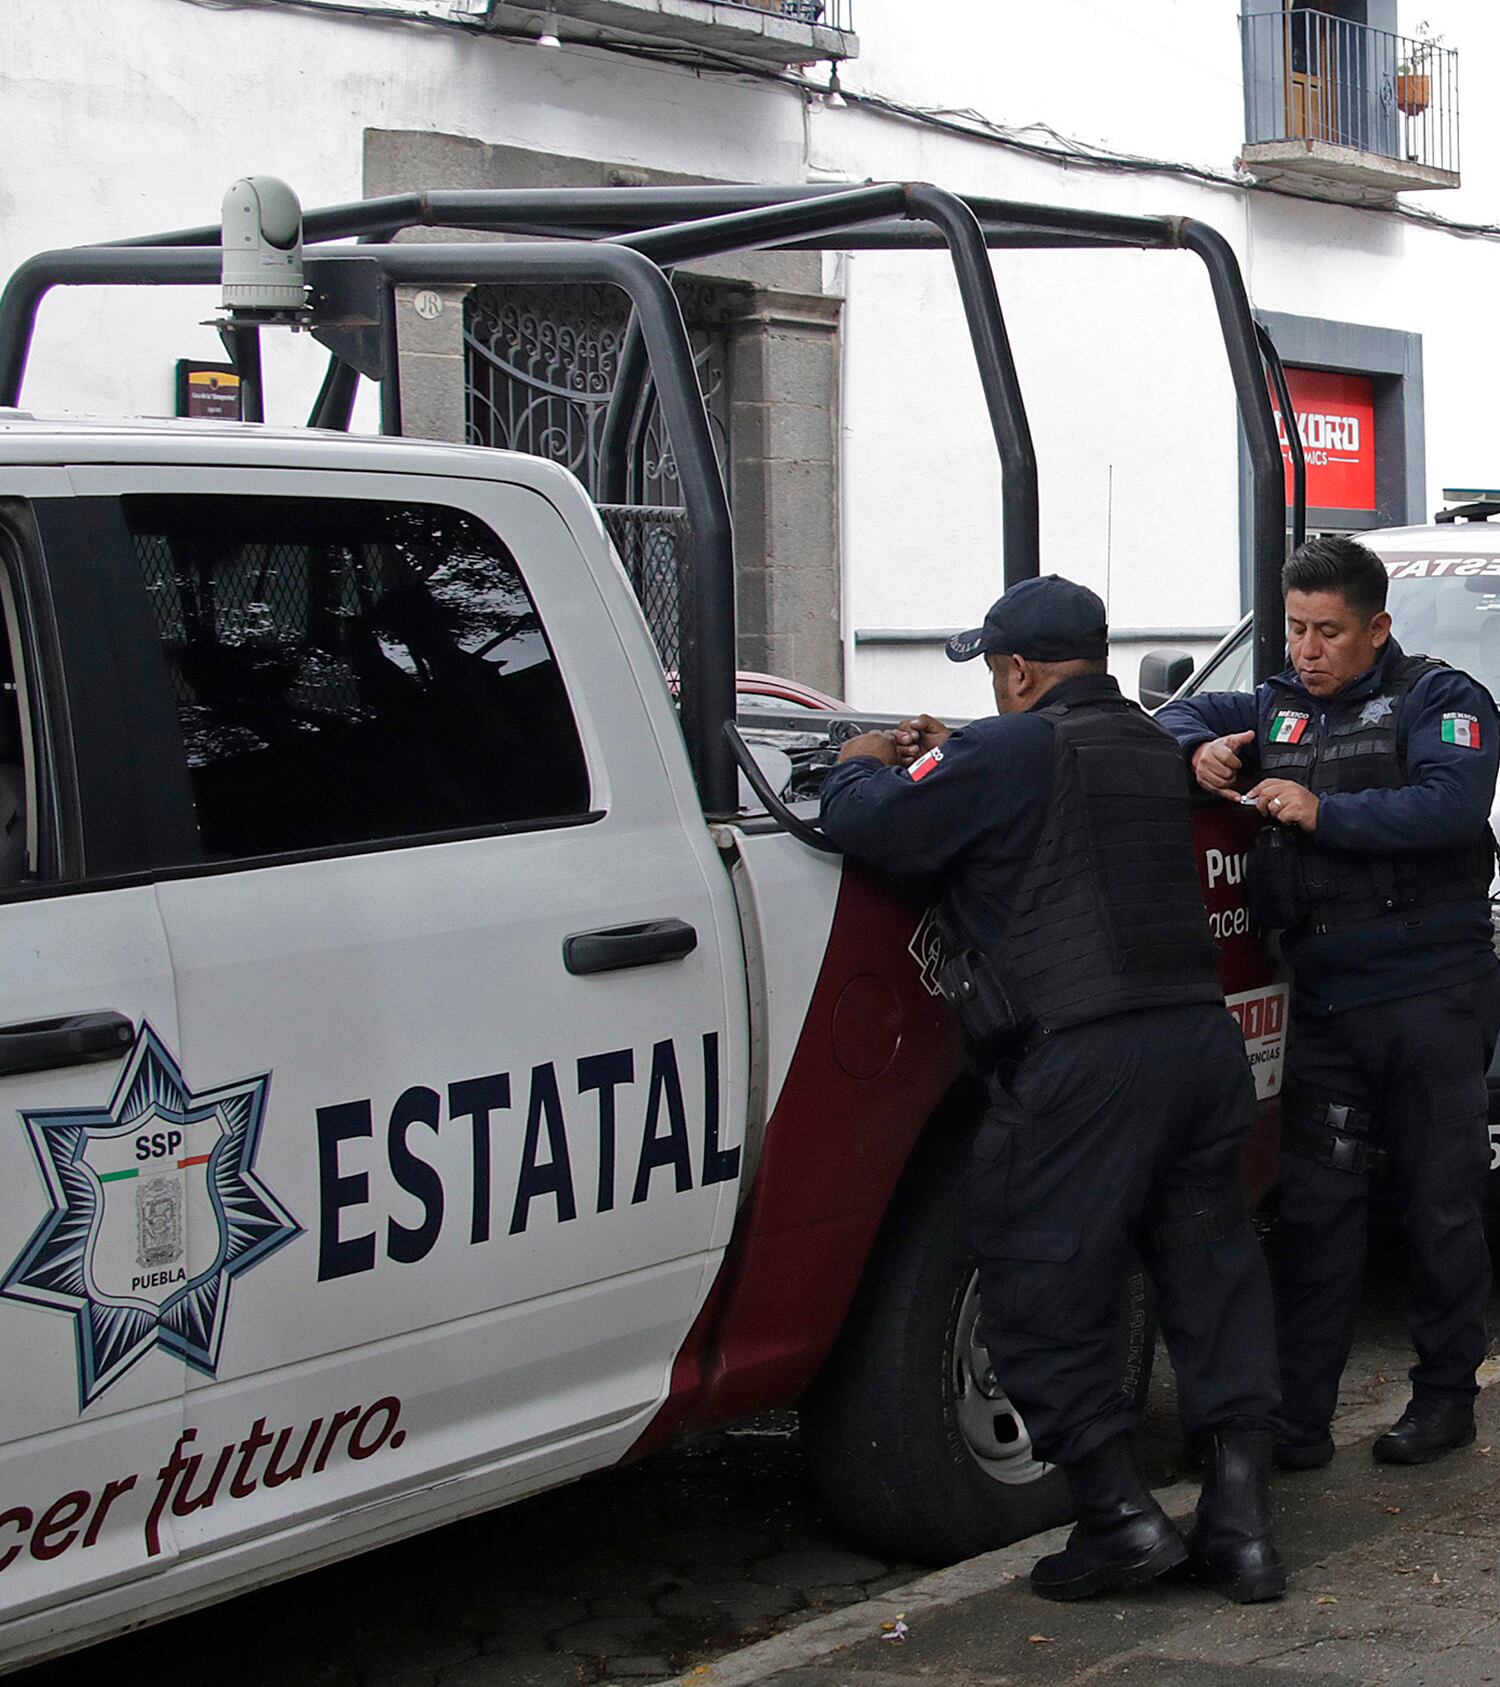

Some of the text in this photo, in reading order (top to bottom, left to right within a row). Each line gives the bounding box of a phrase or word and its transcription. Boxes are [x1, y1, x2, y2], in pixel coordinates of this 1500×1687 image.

[135, 1130, 182, 1161] SSP
[315, 1031, 741, 1282] ESTATAL
[131, 1267, 187, 1291] PUEBLA
[144, 1395, 407, 1558] futuro.
